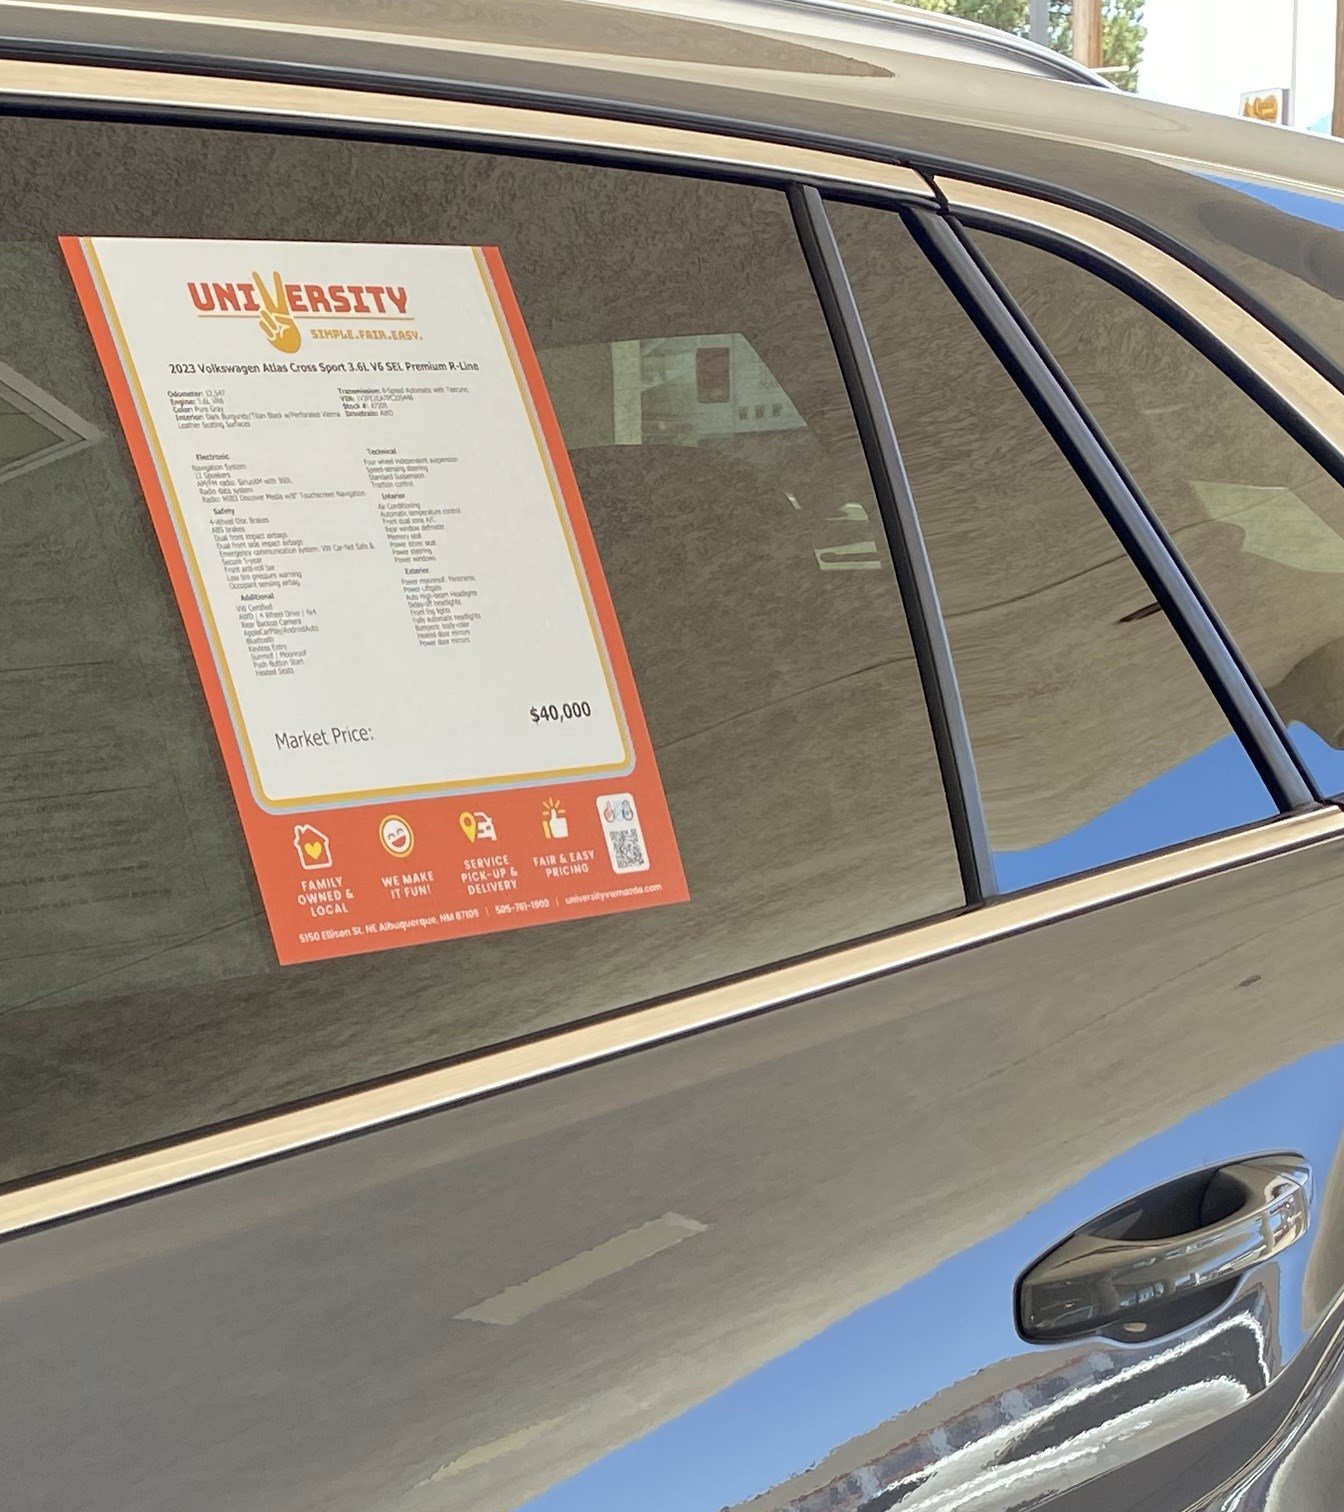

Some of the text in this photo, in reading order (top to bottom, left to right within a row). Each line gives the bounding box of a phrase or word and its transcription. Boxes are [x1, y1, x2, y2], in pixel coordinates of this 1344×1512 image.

[169, 362, 479, 374] 2023 Volkswagen Atlas Cross Sport 3.6L V6 SEL Premium R-Line
[529, 701, 591, 724] $40,000
[274, 725, 374, 750] Market Price:
[464, 855, 509, 870] SERVICE
[533, 850, 595, 867] FAIR & EASY
[381, 871, 434, 887] WE MAKE
[461, 867, 518, 883] PICK-UP &
[545, 864, 589, 878] PRICING
[301, 876, 343, 892] FAMILY
[390, 885, 431, 899] IT FUN!
[468, 880, 517, 895] DELIVERY
[298, 889, 354, 906] OWNED &
[310, 902, 348, 917] LOCAL
[299, 932, 320, 944] 5150
[322, 929, 351, 941] Ellison
[366, 925, 377, 933] NE
[440, 913, 454, 922] NM
